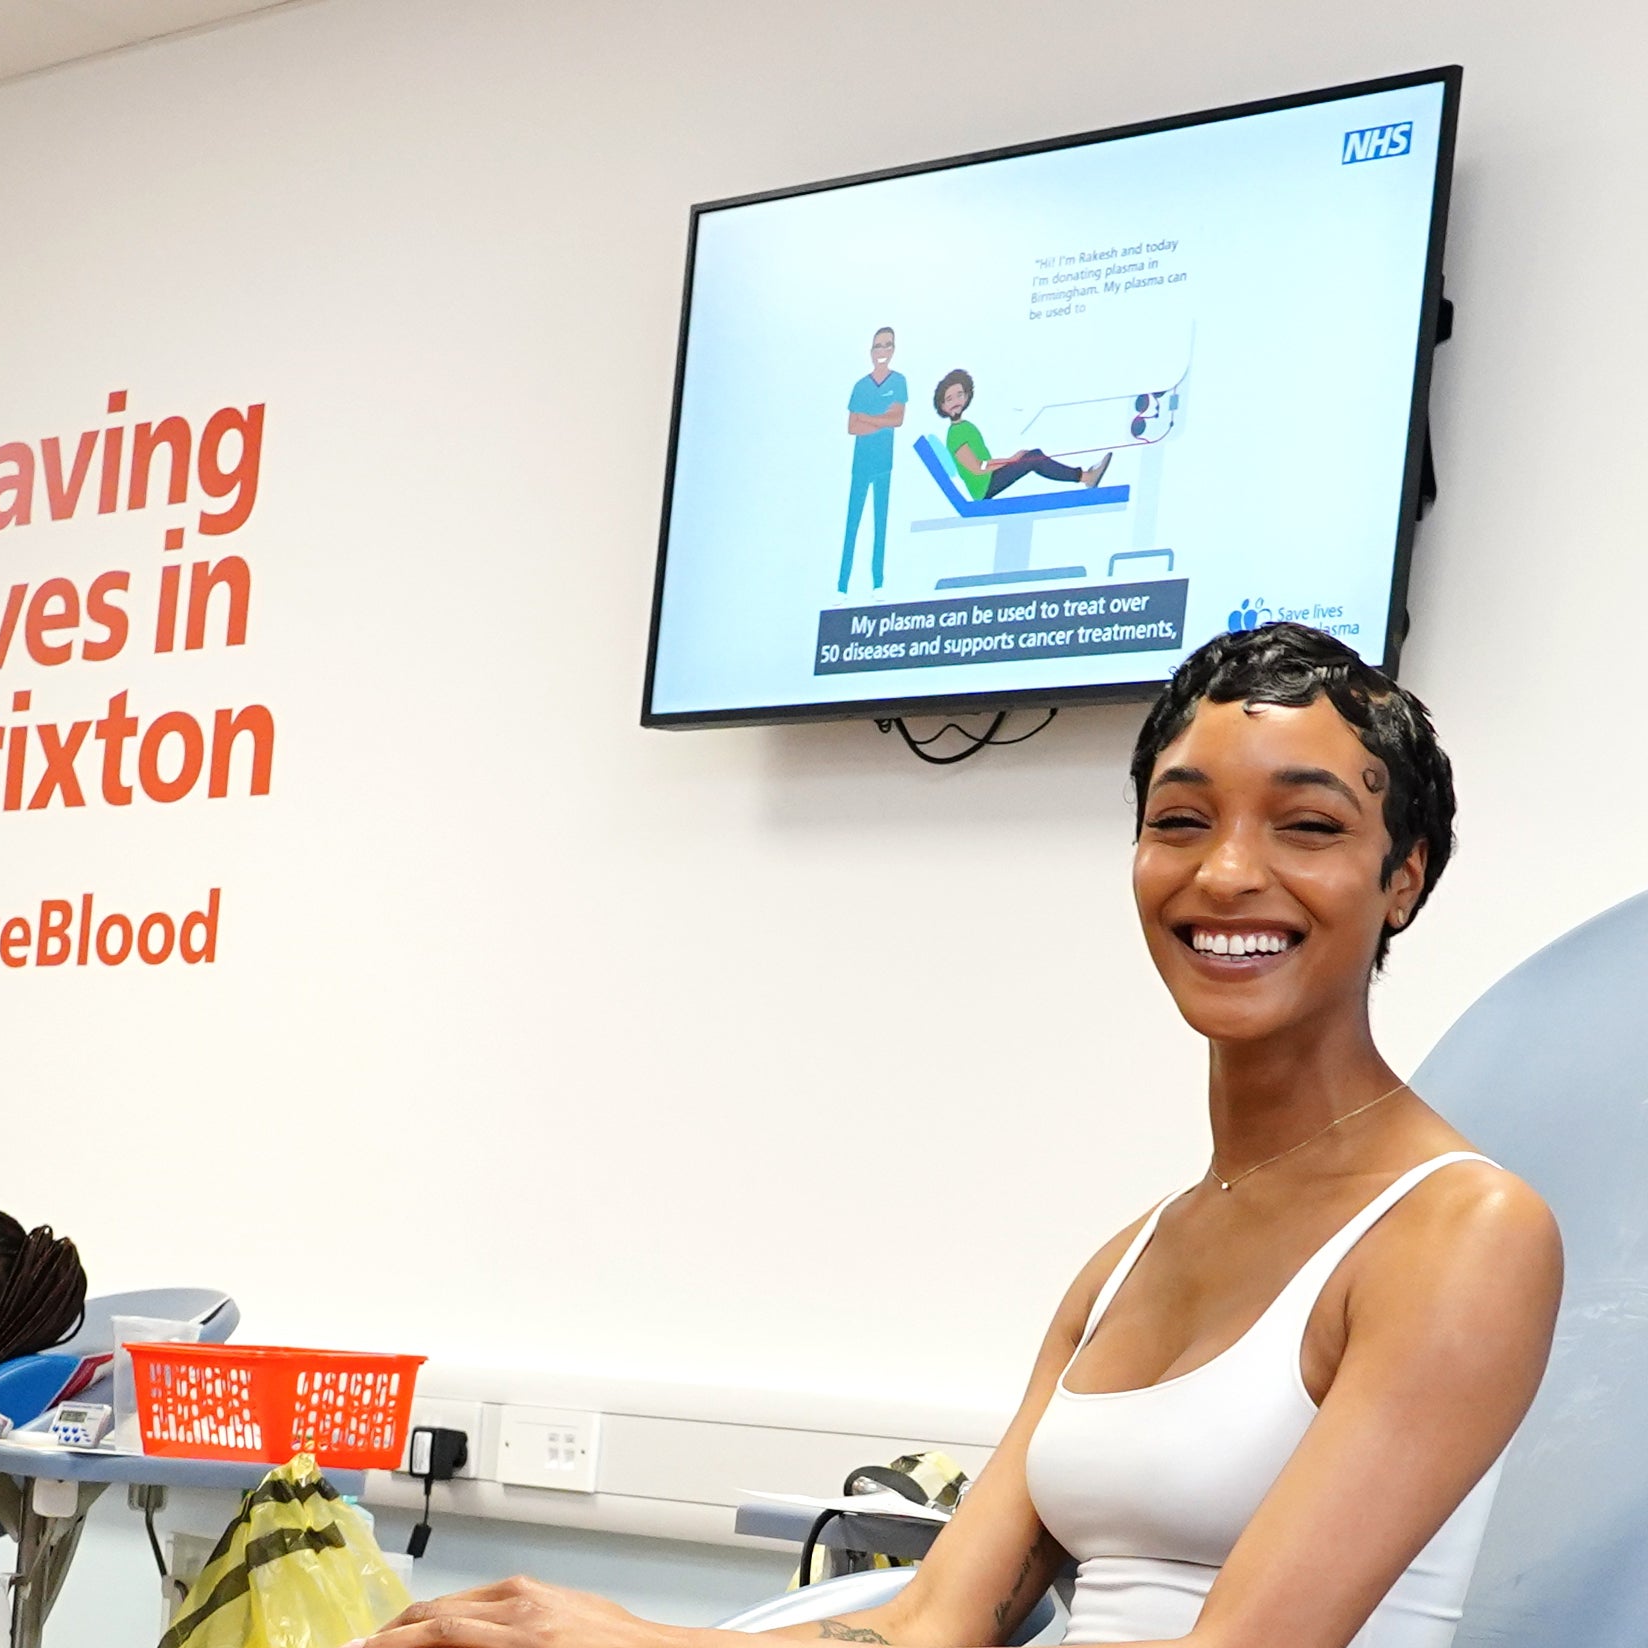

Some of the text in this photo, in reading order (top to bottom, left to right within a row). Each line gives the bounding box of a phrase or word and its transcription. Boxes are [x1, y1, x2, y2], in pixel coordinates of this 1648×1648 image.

[1343, 123, 1412, 163] NHS
[1078, 247, 1118, 264] Rakesh
[1121, 243, 1143, 257] and
[1146, 239, 1179, 254] today
[1052, 268, 1102, 285] donating
[1105, 261, 1145, 279] plasma
[1148, 257, 1159, 270] in
[1103, 281, 1121, 295] My
[1124, 273, 1165, 293] plasma
[1167, 271, 1187, 284] can
[1029, 303, 1087, 321] be used to
[154, 527, 252, 654] in
[851, 594, 1150, 638] My plasma can be used to treat over
[1277, 603, 1344, 623] Save lives
[820, 619, 1178, 664] 50 diseases and supports cancer treatments,
